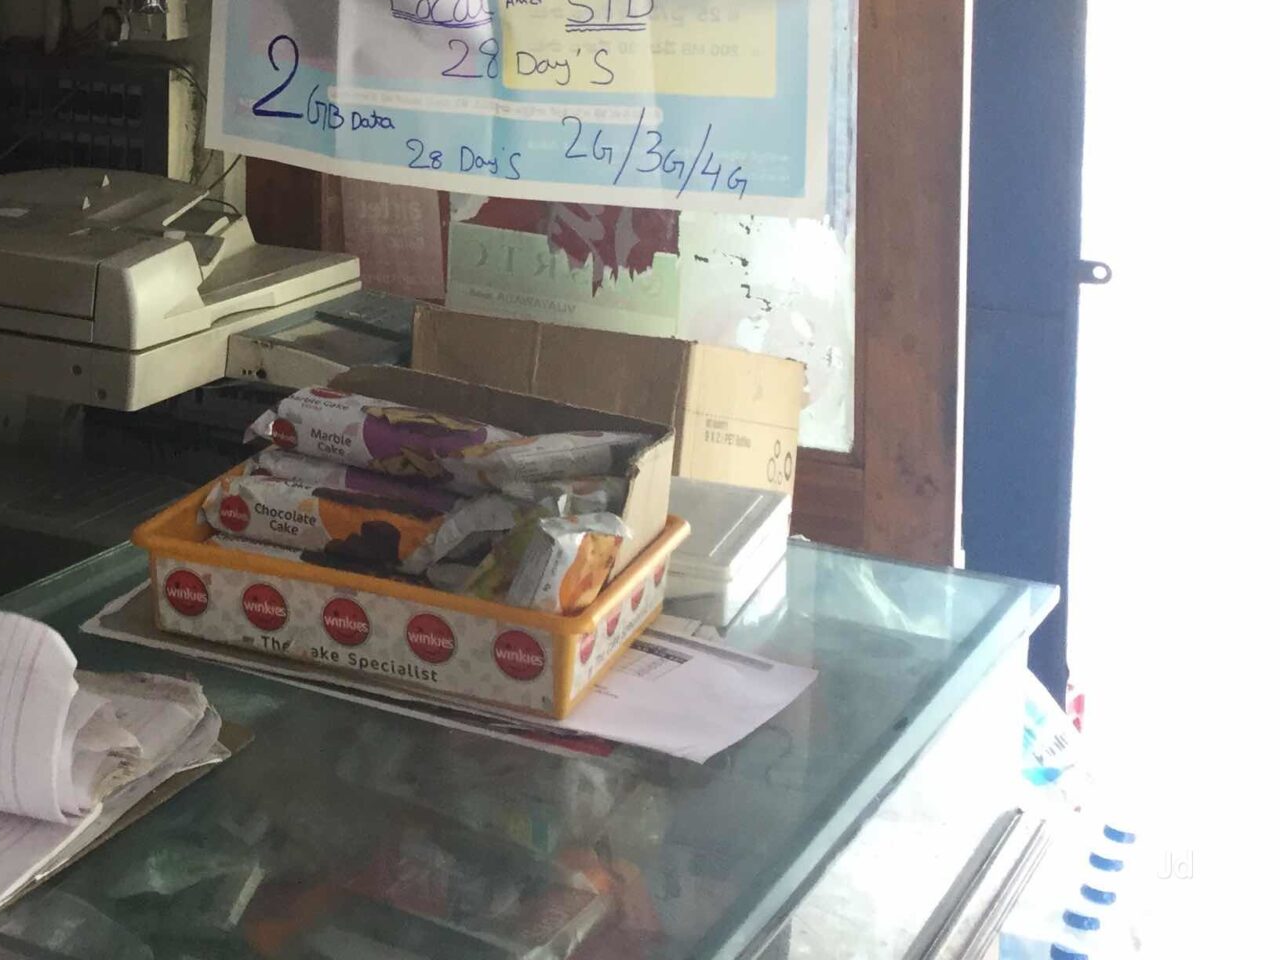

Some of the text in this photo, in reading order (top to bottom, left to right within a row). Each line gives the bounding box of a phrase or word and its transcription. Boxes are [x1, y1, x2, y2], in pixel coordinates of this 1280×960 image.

[441, 38, 500, 79] 28
[351, 107, 396, 131] Data
[405, 138, 443, 171] 28
[310, 427, 352, 447] Marble
[317, 442, 345, 456] Cake
[254, 502, 317, 527] Chocolate
[269, 519, 300, 536] Cake
[166, 583, 208, 604] winkies
[244, 596, 287, 618] winkies
[323, 612, 368, 633] winkies
[407, 628, 456, 650] winkies
[261, 634, 438, 683] The ake Specialist
[495, 645, 545, 667] winkies
